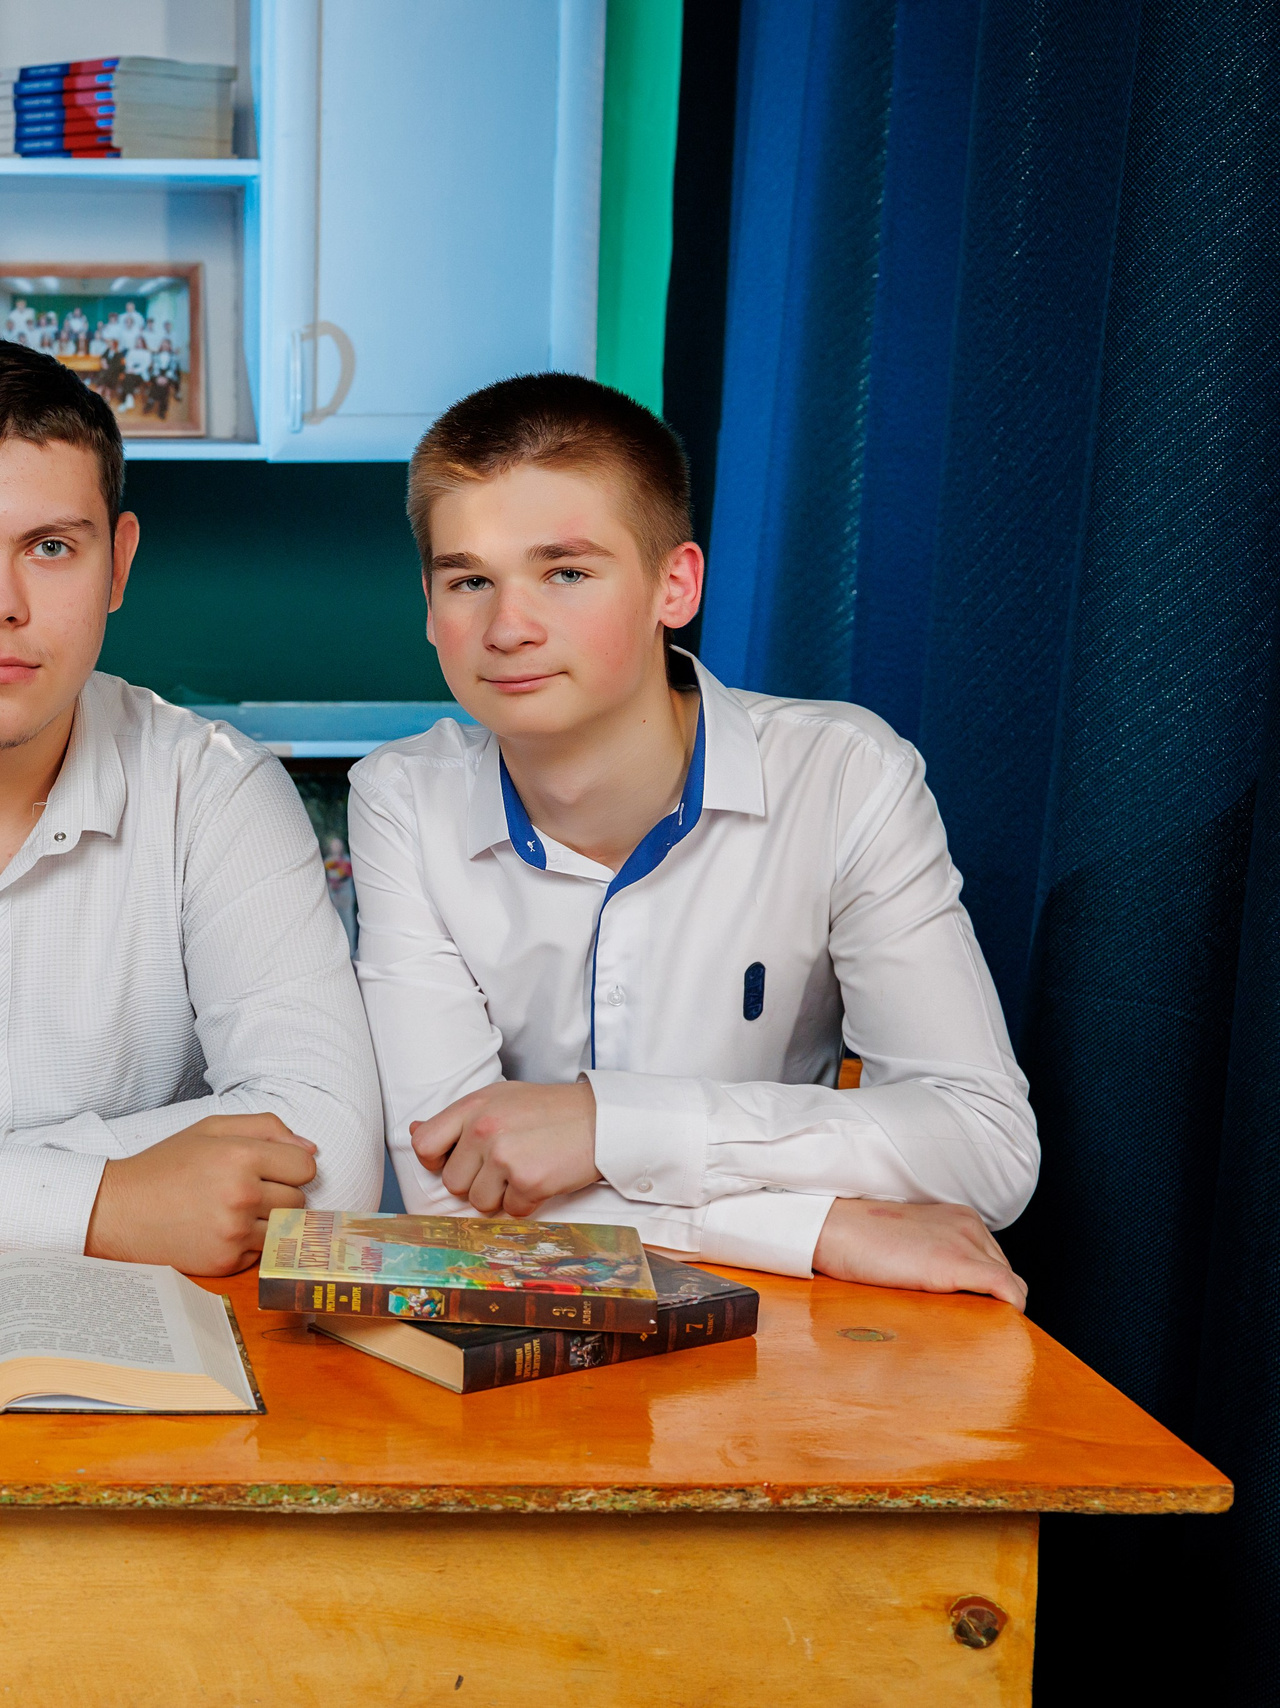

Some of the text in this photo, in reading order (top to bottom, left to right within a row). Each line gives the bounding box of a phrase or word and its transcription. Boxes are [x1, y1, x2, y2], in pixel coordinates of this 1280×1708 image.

[298, 1210, 335, 1270] ХРЕСТОМАТИЯ
[347, 1246, 384, 1273] 3 класс
[552, 1306, 577, 1318] 3
[685, 1323, 704, 1333] 7
